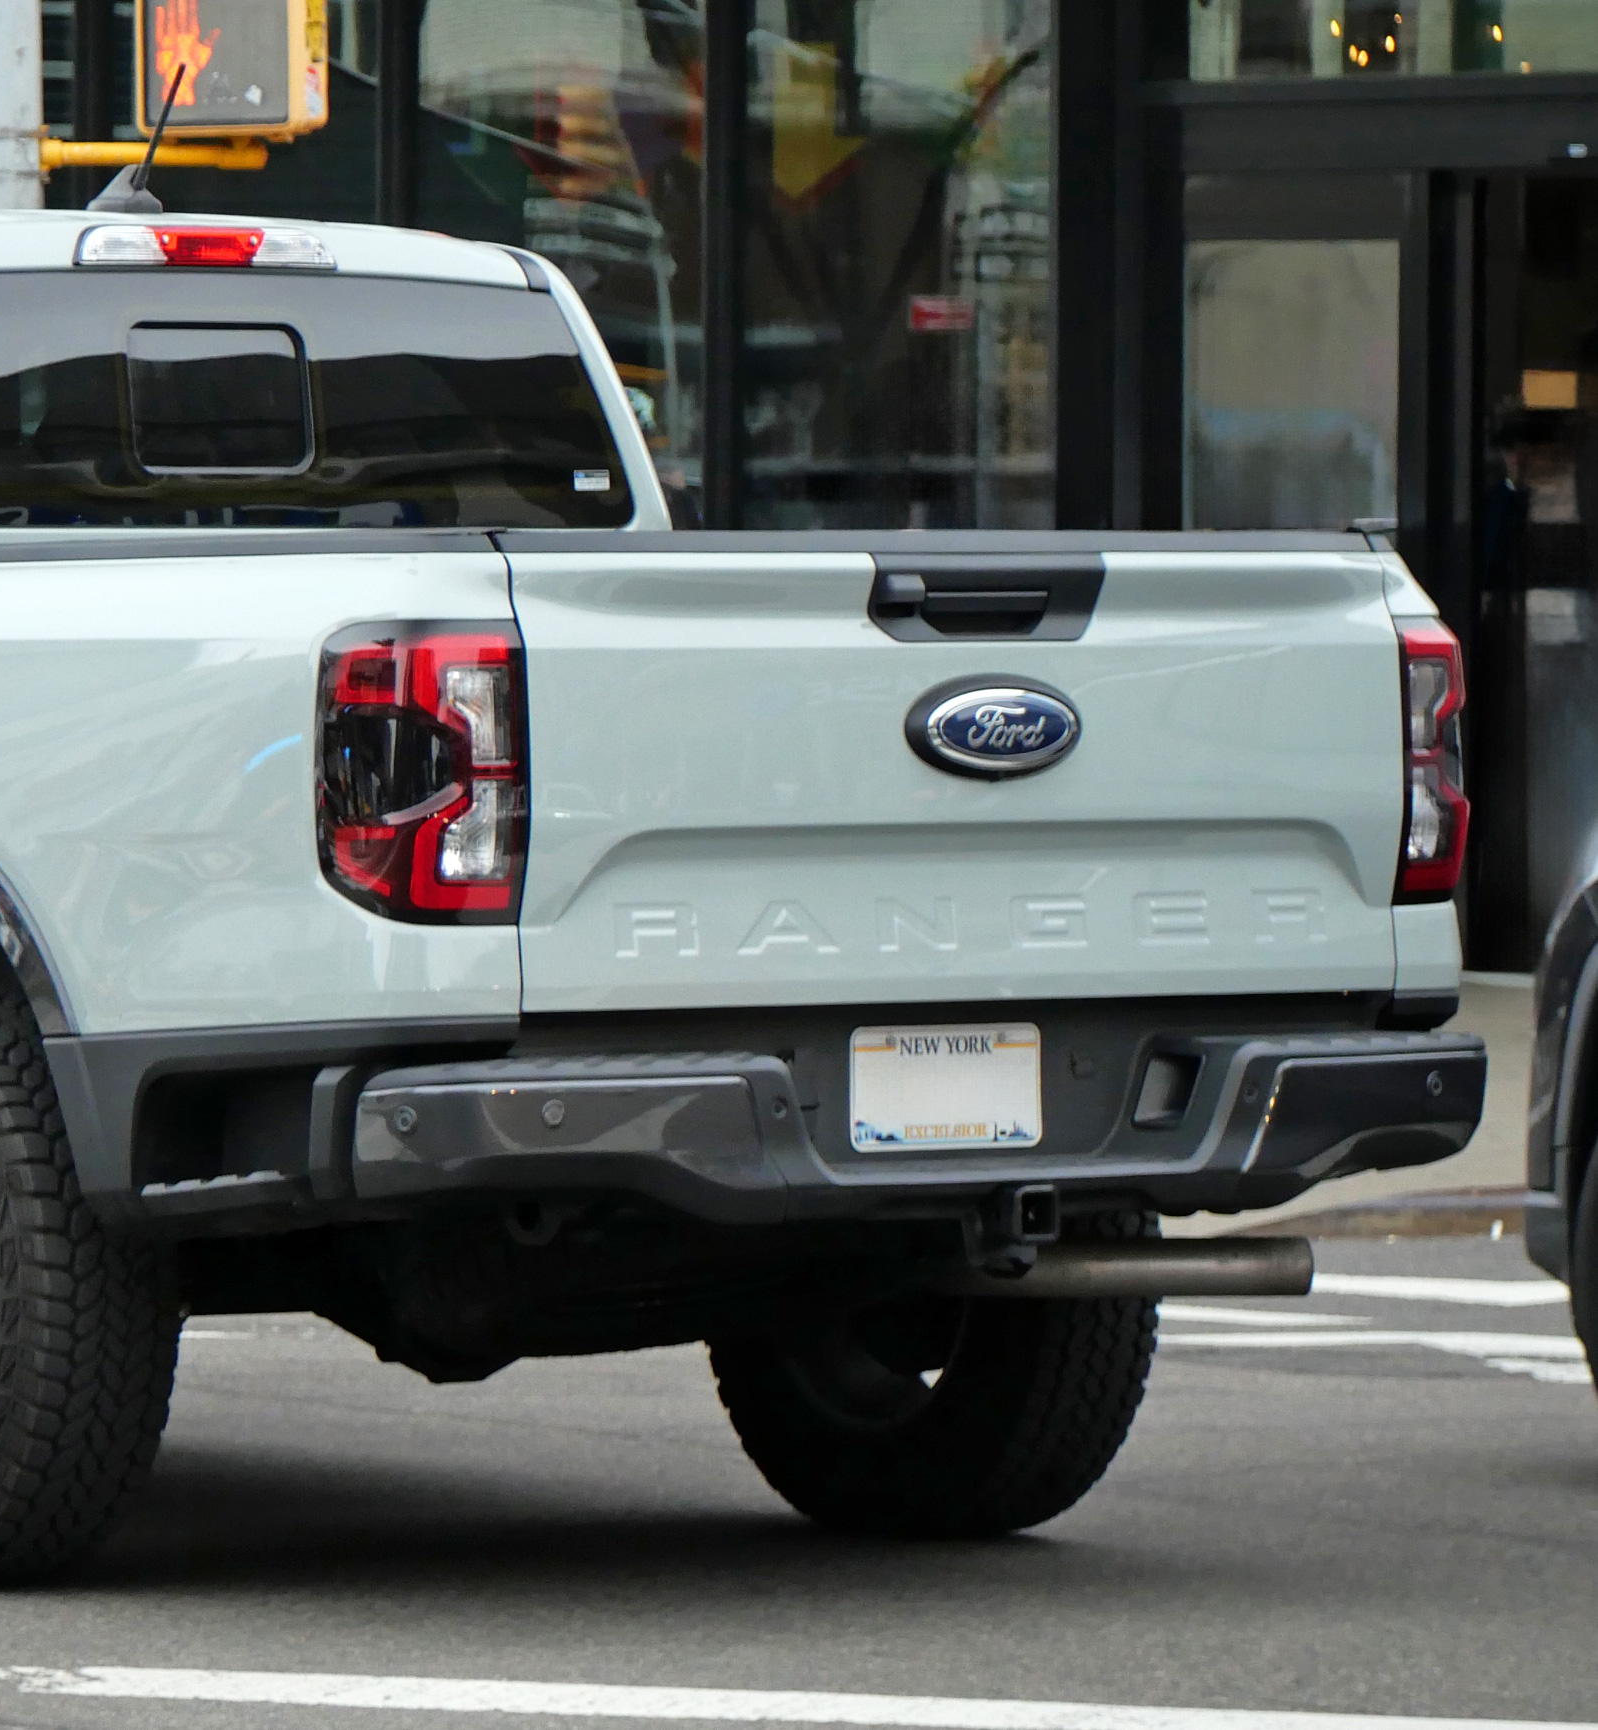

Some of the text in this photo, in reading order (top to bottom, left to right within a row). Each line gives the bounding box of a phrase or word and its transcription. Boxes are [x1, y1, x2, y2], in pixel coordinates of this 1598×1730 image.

[967, 704, 1048, 750] Ford
[612, 888, 1328, 957] RANGER
[900, 1034, 993, 1056] NEW YORK
[904, 1123, 988, 1140] EXCELSIOR
